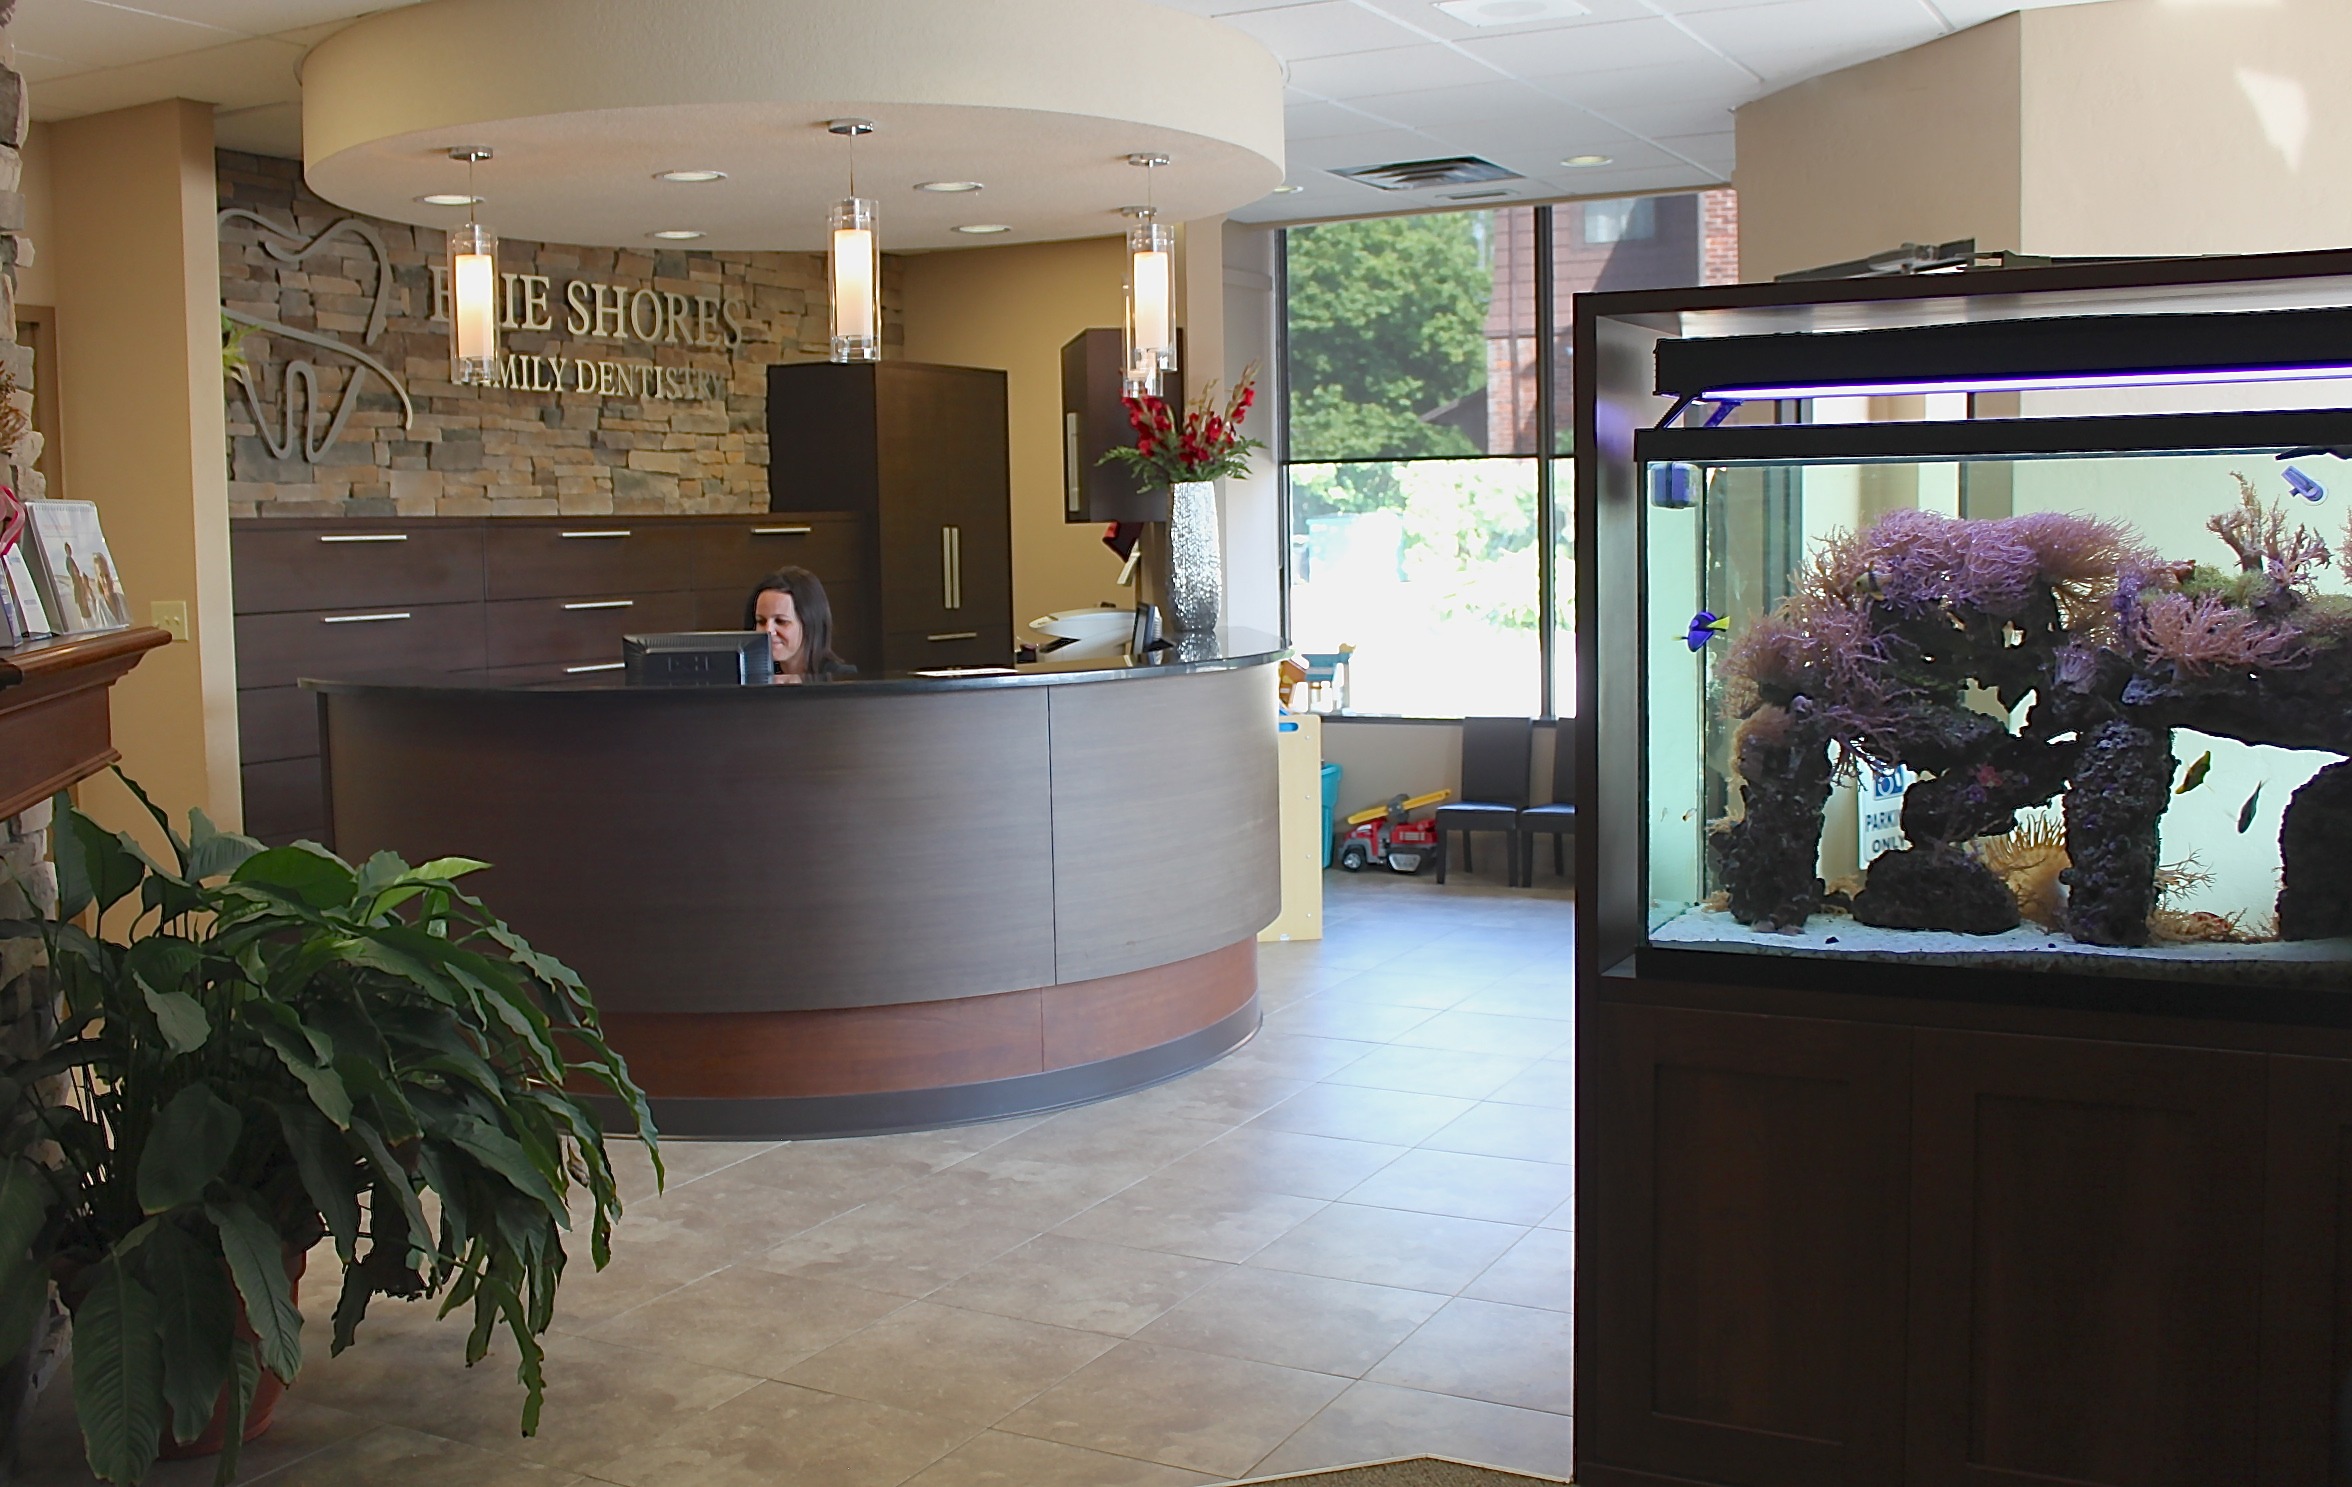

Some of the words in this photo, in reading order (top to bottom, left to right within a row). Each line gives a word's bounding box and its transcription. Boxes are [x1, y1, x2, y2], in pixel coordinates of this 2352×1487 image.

[428, 264, 552, 331] EIE
[567, 279, 742, 348] SHORES
[575, 358, 726, 401] DENTISTRY
[1872, 835, 1905, 853] ONLY
